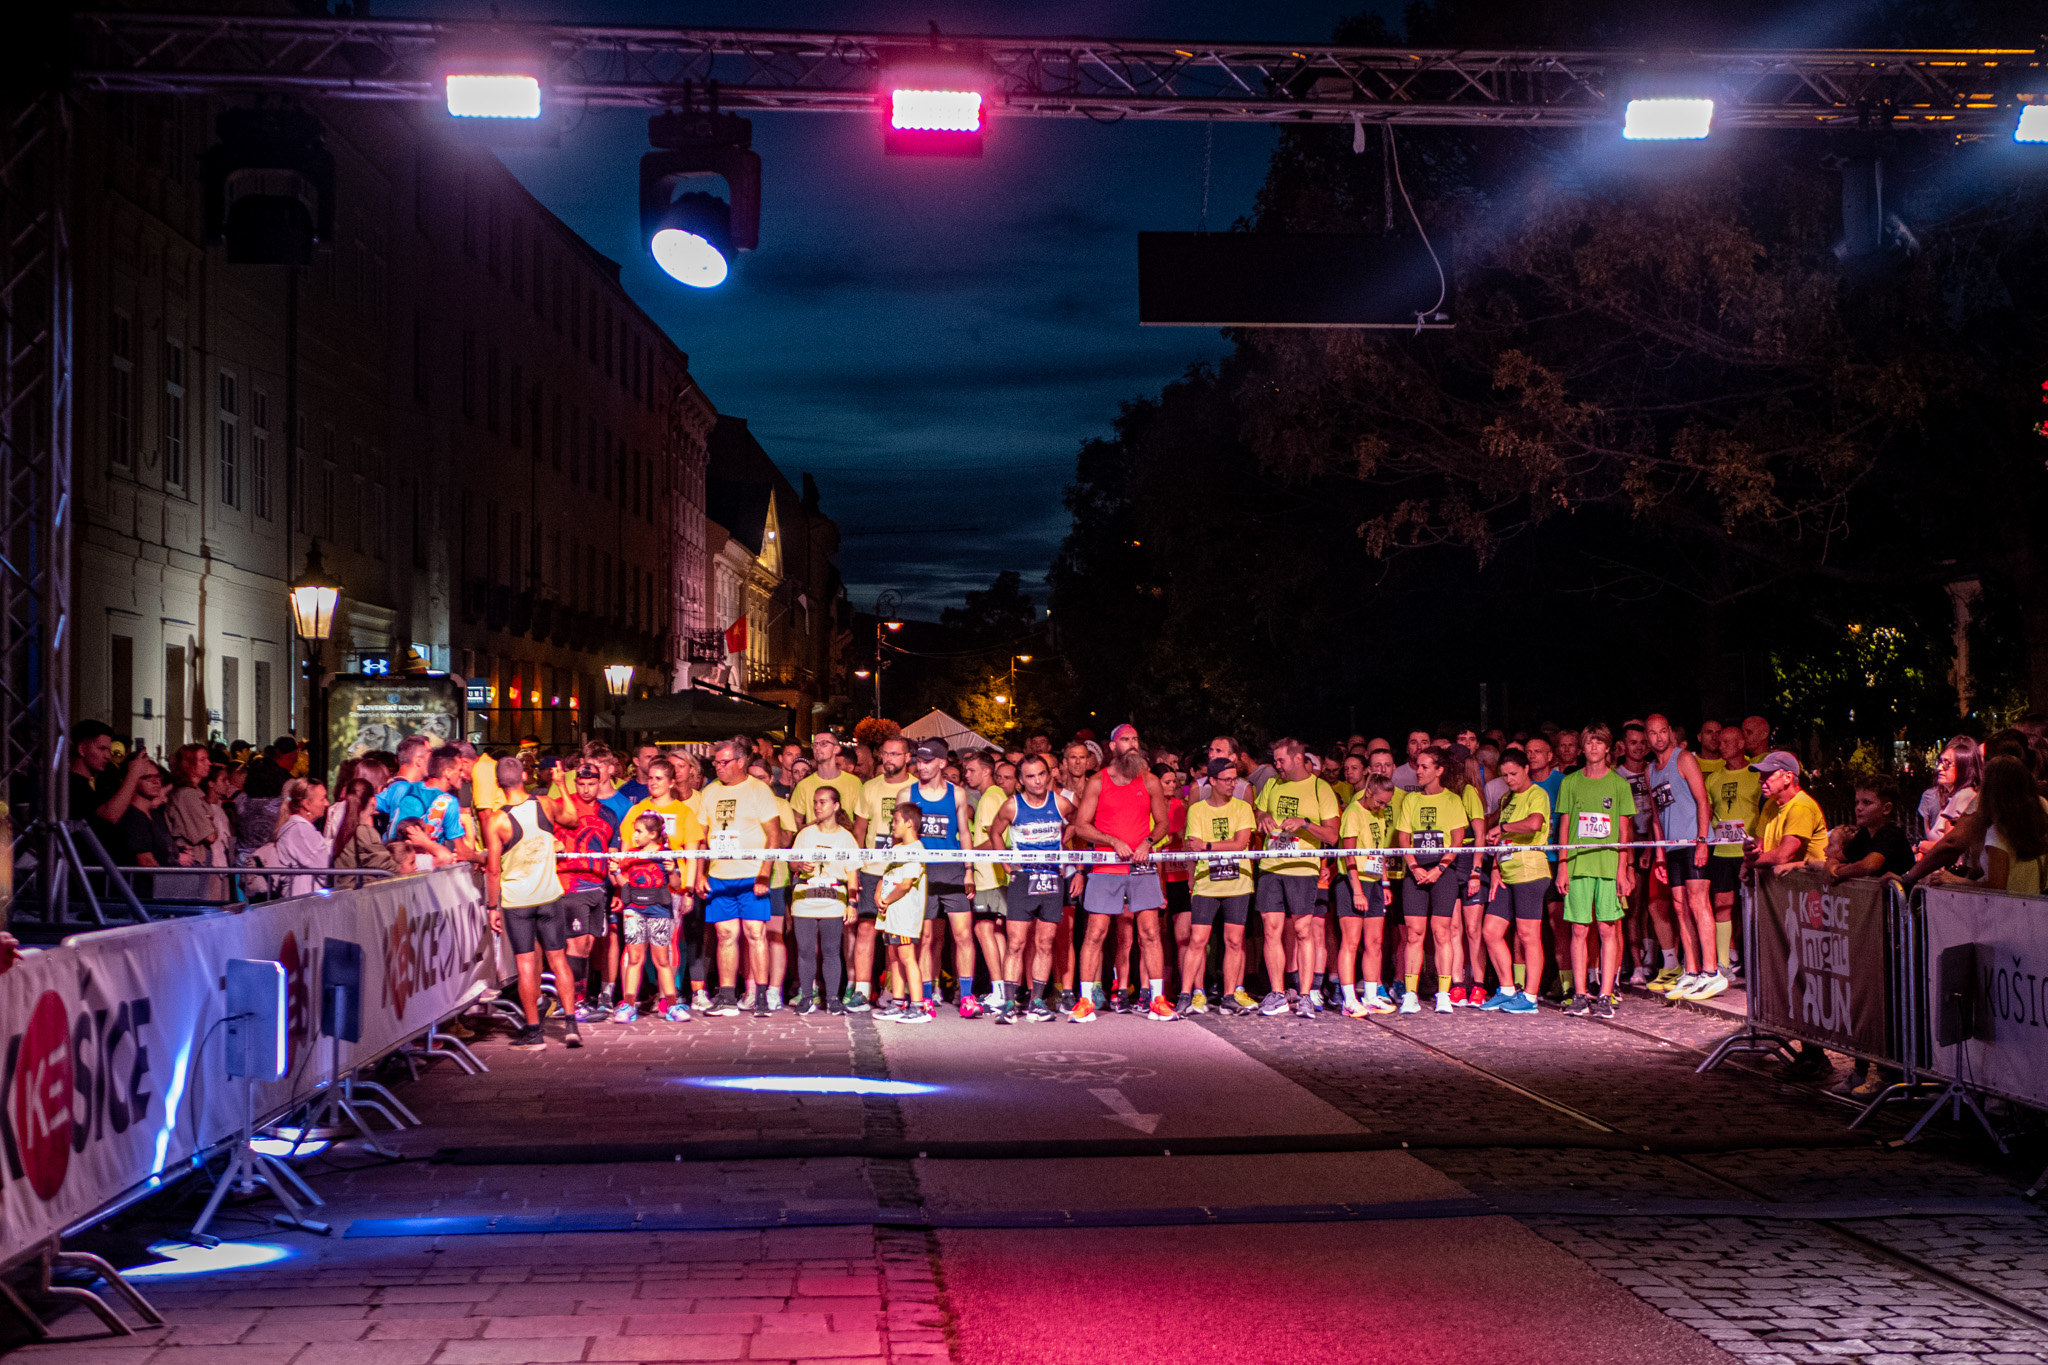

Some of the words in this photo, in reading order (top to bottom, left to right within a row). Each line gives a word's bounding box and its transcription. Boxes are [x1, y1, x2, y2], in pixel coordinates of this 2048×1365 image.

[356, 703, 397, 711] SLOVENSKÝ
[407, 711, 435, 719] plemeno
[716, 810, 735, 818] RUN
[1277, 807, 1297, 816] RUN
[923, 823, 939, 834] 783
[1032, 825, 1059, 835] essity
[1585, 823, 1602, 833] 1740
[1420, 839, 1436, 848] 488
[1216, 865, 1234, 876] 745
[1036, 881, 1052, 891] 654
[1803, 930, 1850, 974] night
[1802, 971, 1853, 1037] RUN
